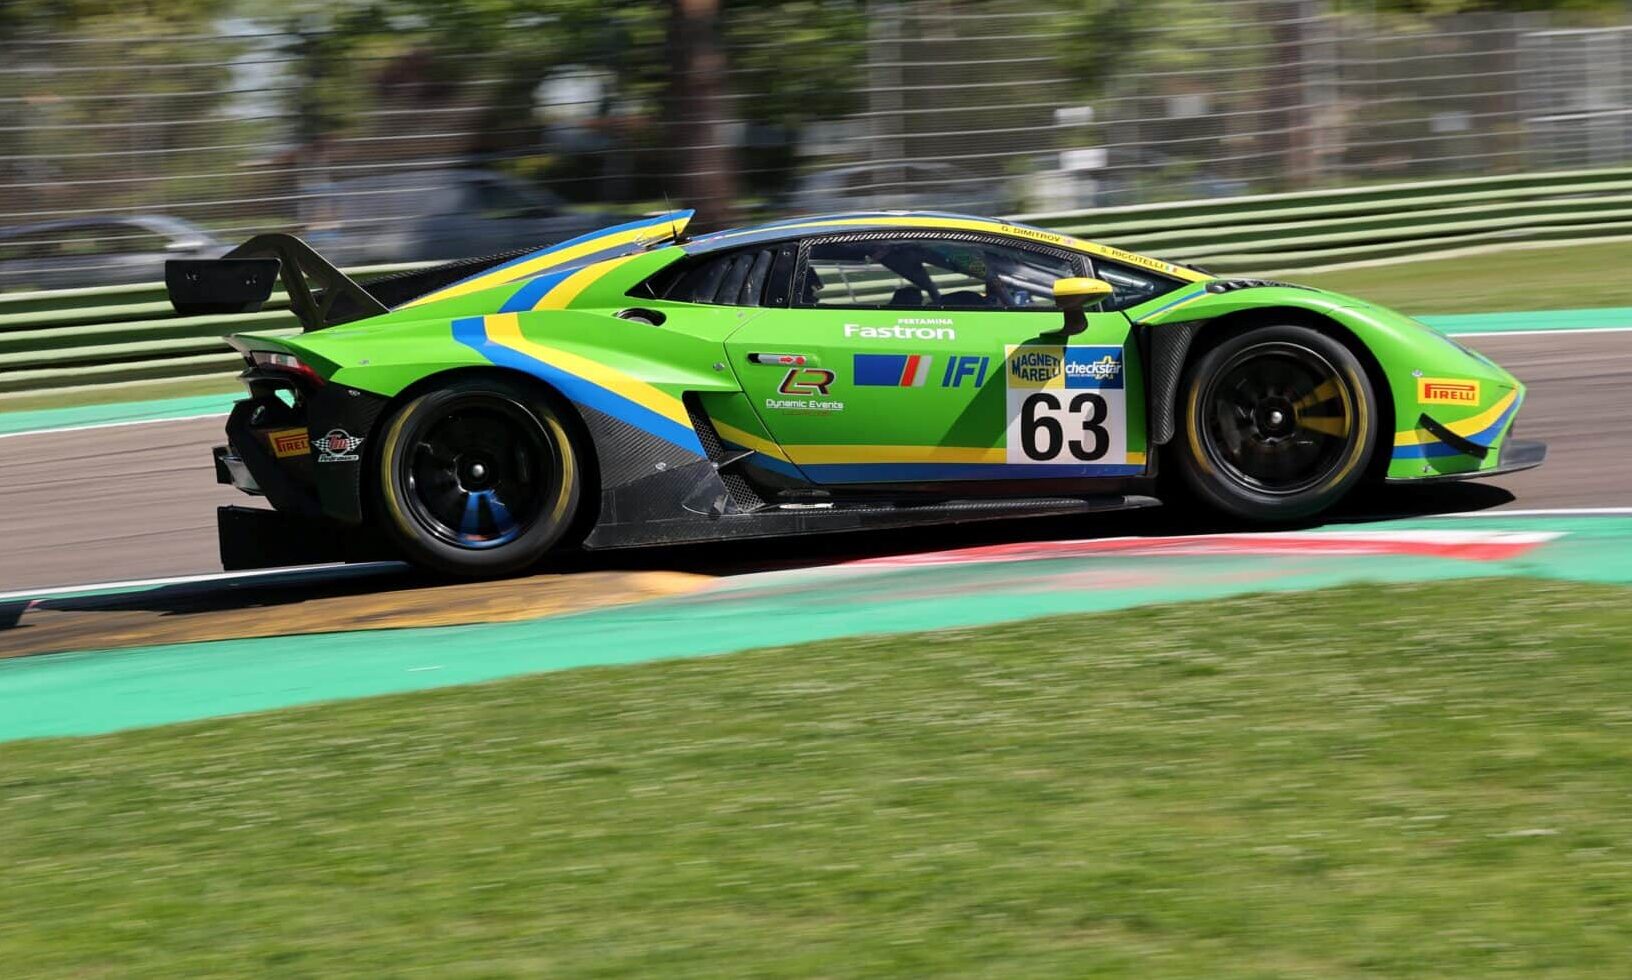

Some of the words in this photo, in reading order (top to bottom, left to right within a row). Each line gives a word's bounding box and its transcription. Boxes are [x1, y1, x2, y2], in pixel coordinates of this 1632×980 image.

[1013, 227, 1061, 242] DIMITROV
[1112, 249, 1164, 269] RICCITELLI
[844, 323, 956, 340] Fastron
[1011, 352, 1061, 370] MAGNETI
[1065, 361, 1122, 374] checkstar
[942, 356, 990, 388] IFI
[1011, 362, 1062, 382] MARELLI
[1424, 383, 1476, 401] PIRELLI
[765, 398, 808, 409] Dynamic
[809, 400, 844, 410] Events
[1020, 392, 1110, 462] 63
[275, 433, 309, 452] PIREL
